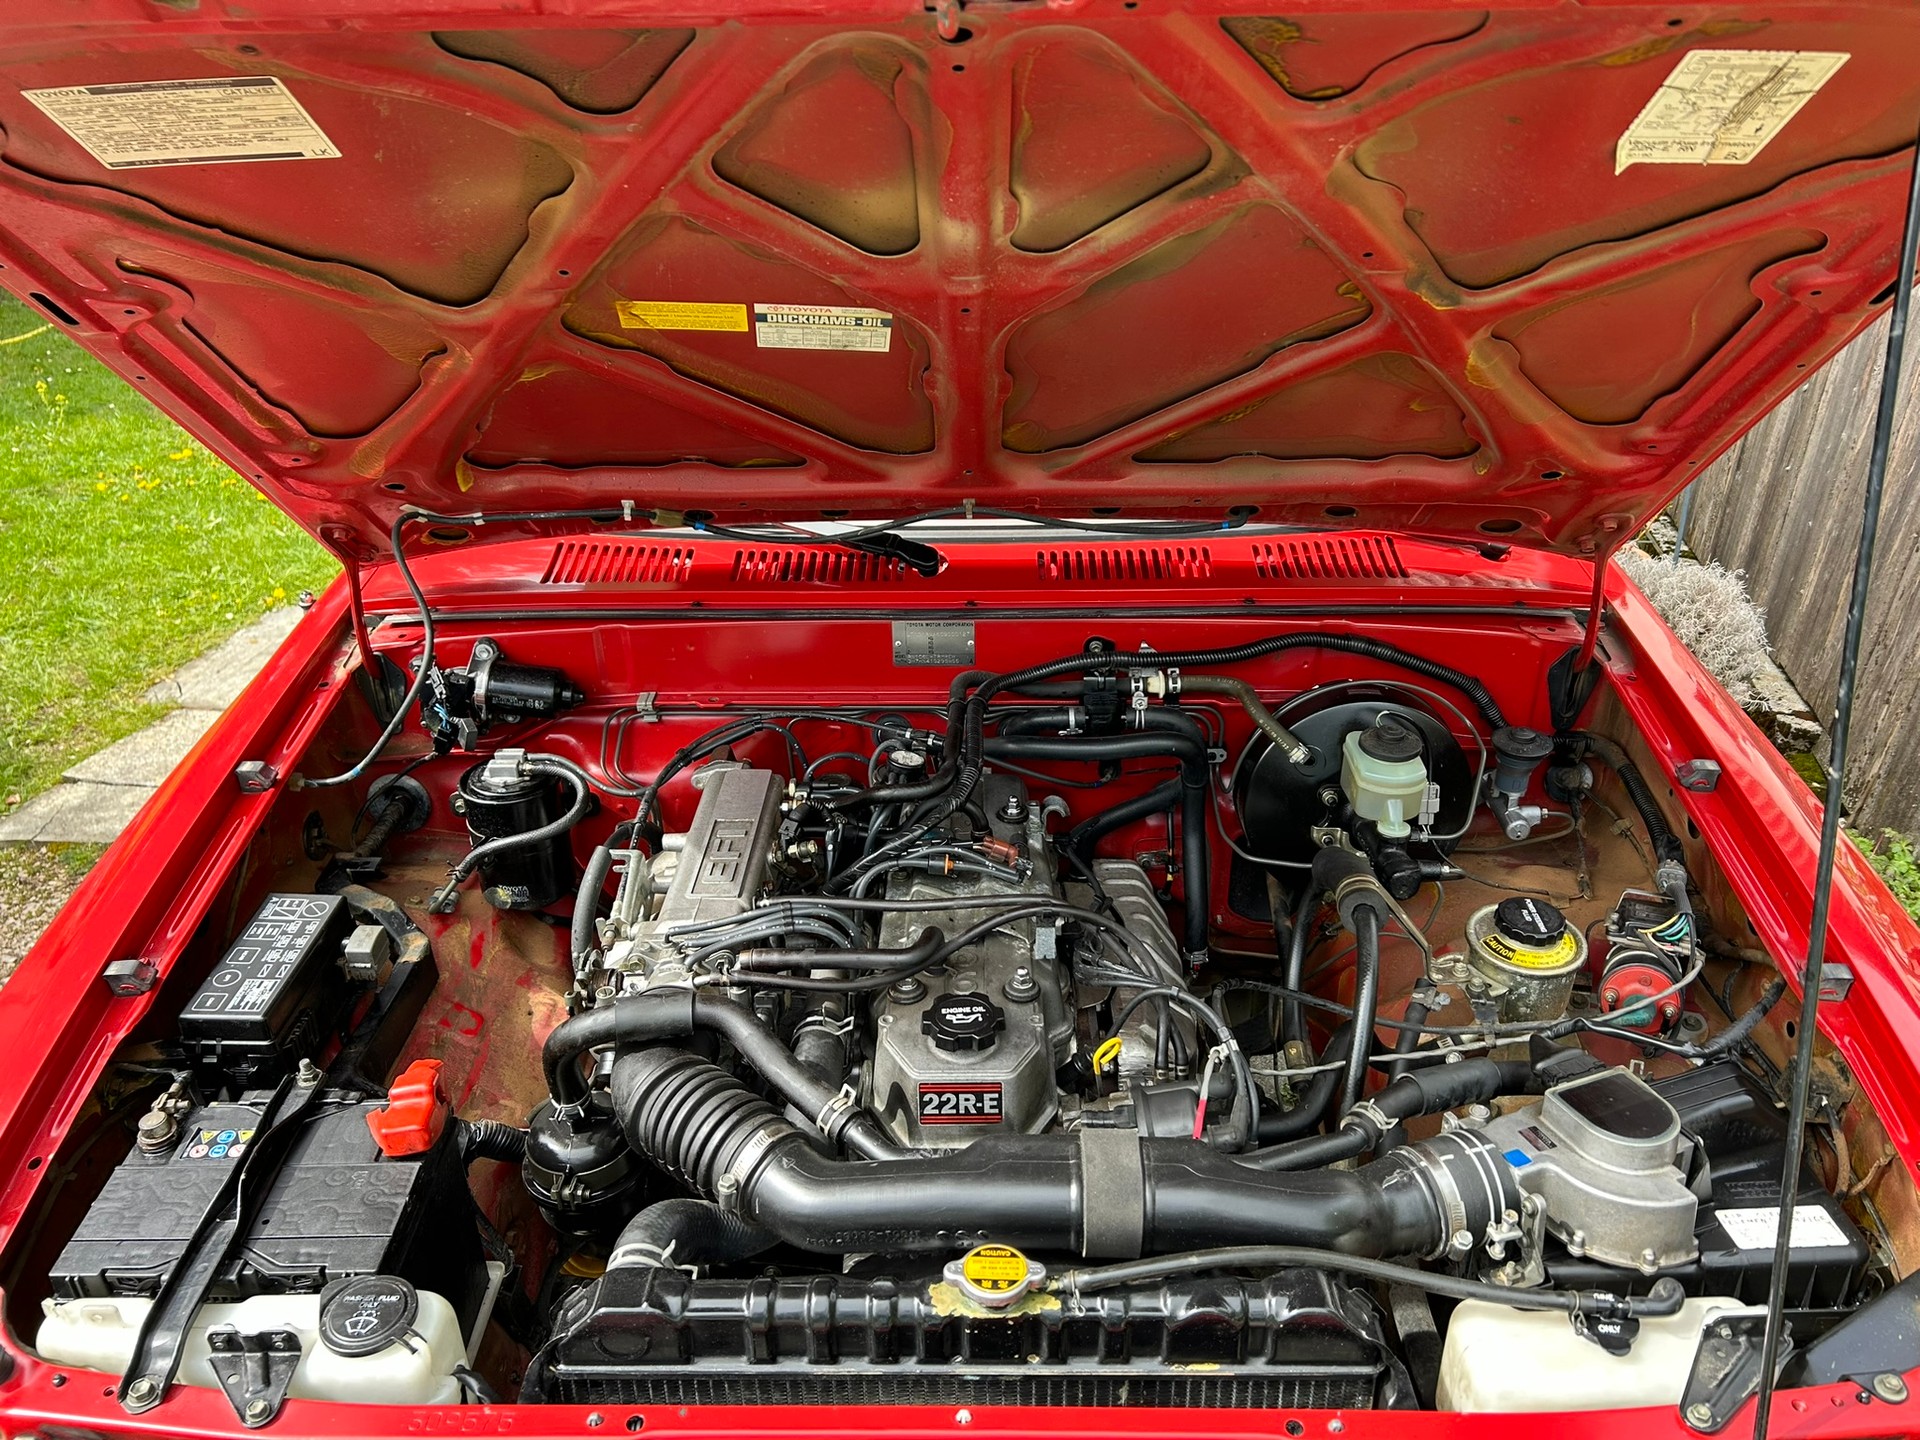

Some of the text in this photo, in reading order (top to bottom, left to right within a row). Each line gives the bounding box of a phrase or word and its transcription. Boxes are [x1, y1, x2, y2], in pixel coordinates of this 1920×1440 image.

[33, 88, 87, 98] TOYOTA
[222, 87, 277, 96] CATALYST
[311, 148, 331, 156] LK
[766, 313, 884, 327] DUCKHAMS-OIL
[701, 829, 748, 884] EFI
[1486, 936, 1515, 958] CAUTION
[941, 1006, 972, 1014] ENGINE
[922, 1093, 999, 1115] 22R-E
[980, 1249, 1011, 1257] CAUTION
[1597, 1324, 1621, 1334] ONLY
